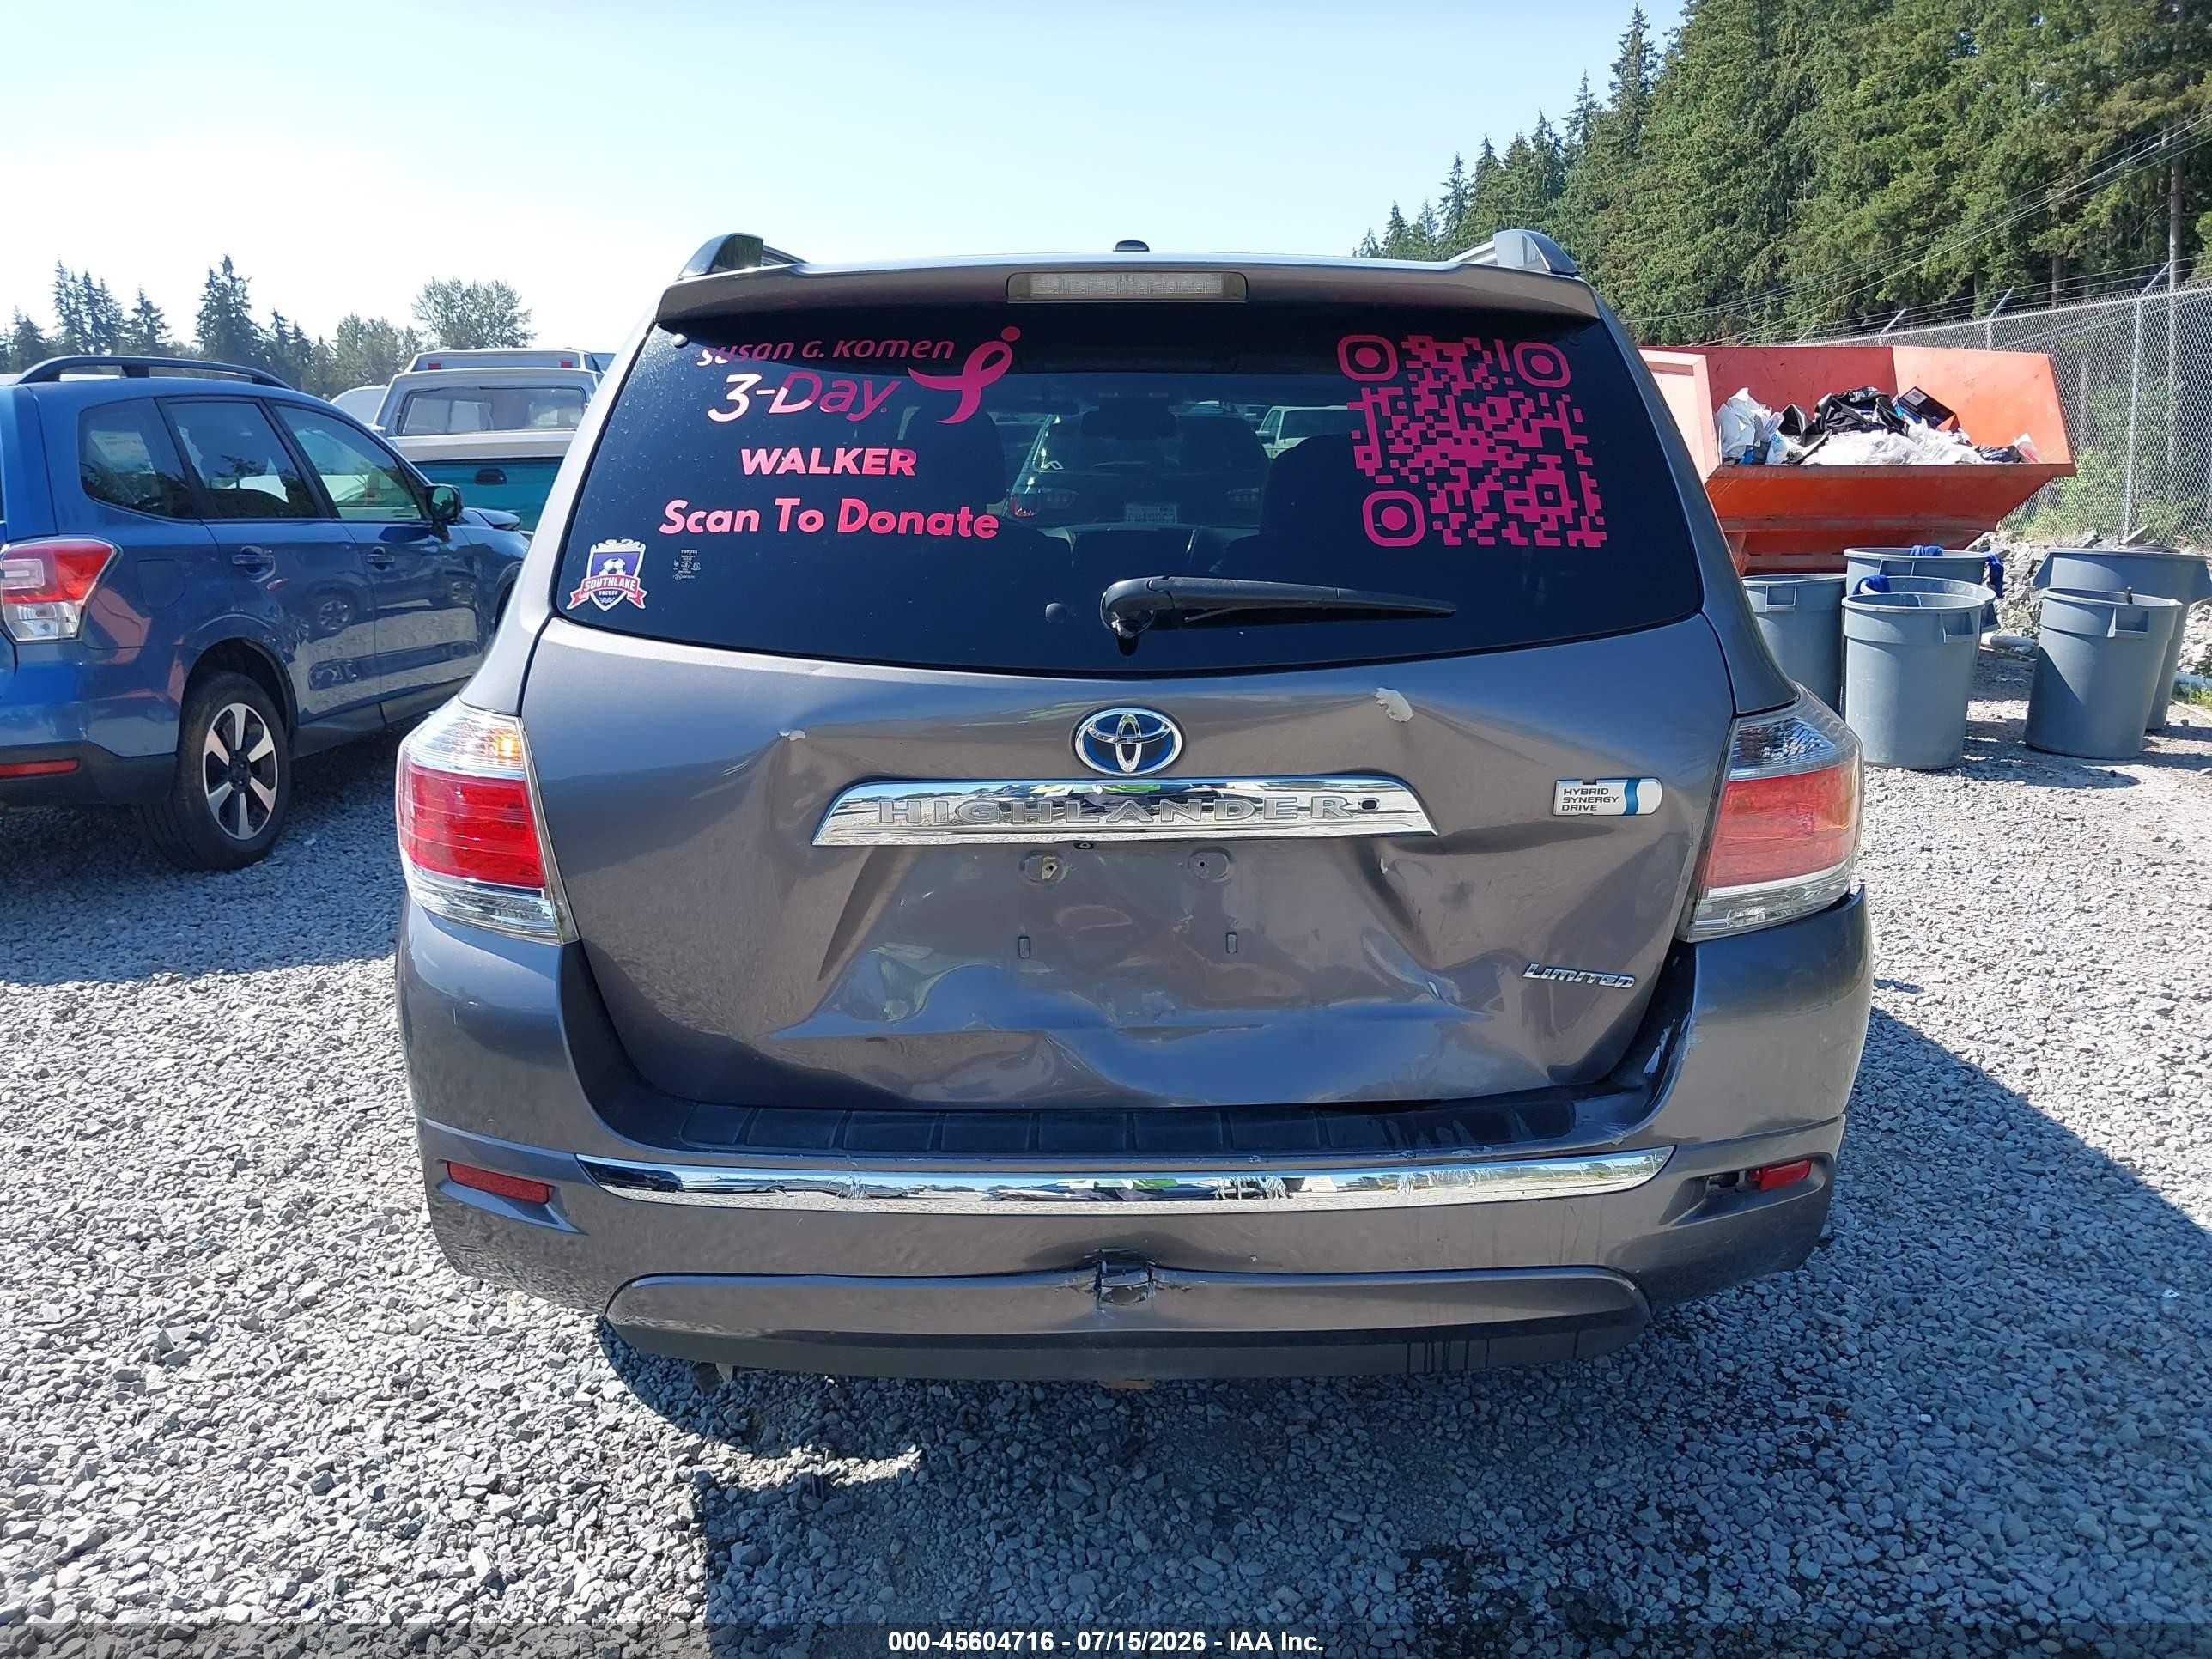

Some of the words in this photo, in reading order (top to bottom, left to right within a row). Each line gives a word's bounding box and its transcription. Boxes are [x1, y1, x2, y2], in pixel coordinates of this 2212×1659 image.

[740, 447, 916, 477] WALKER
[659, 499, 760, 535] Scan
[775, 497, 824, 532] To
[837, 498, 999, 538] Donate
[583, 576, 636, 592] SOUTHLAKE
[1563, 787, 1609, 796] HYBRID
[878, 796, 1354, 823] HIGHLANDER
